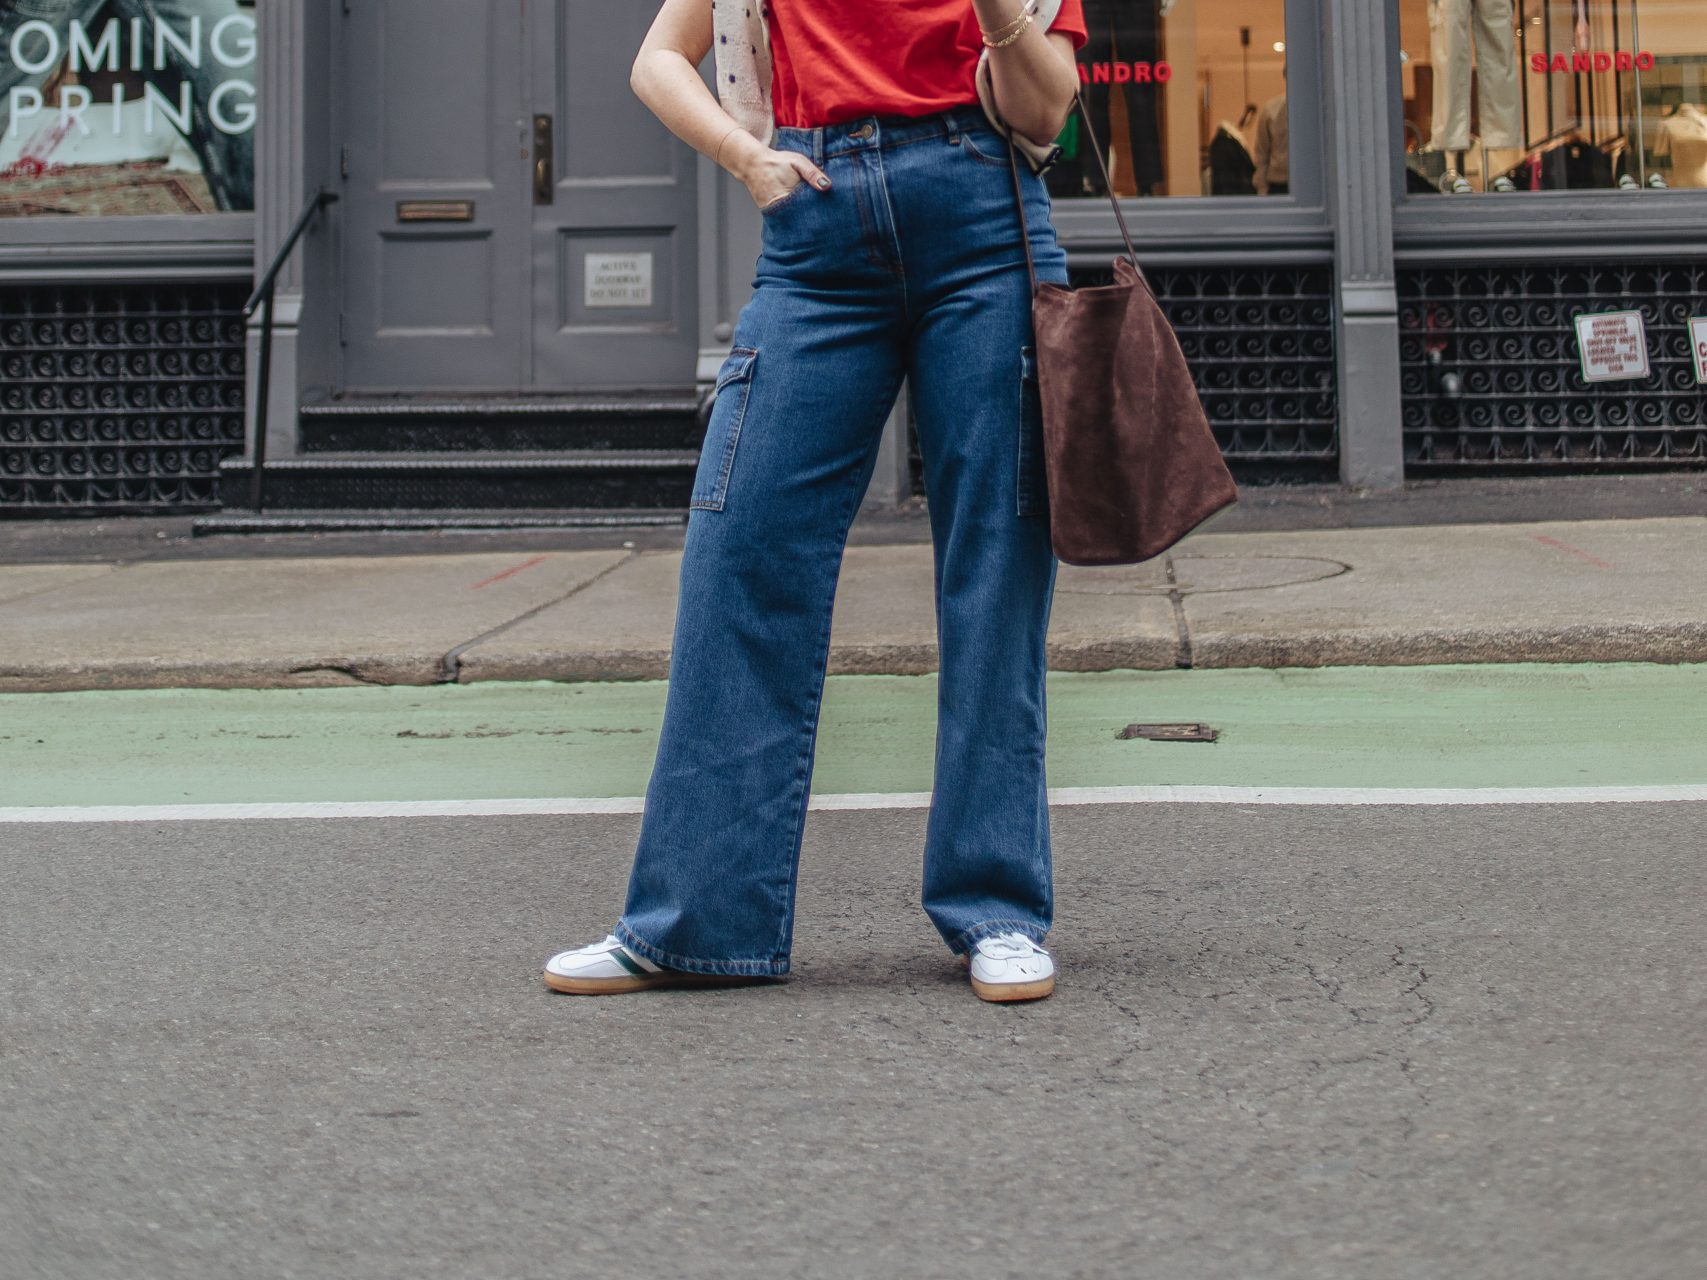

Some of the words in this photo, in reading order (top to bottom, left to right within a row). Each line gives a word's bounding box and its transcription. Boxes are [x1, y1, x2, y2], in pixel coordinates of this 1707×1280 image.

[10, 14, 257, 74] OMING
[1530, 50, 1655, 74] SANDRO
[9, 79, 256, 138] PRING
